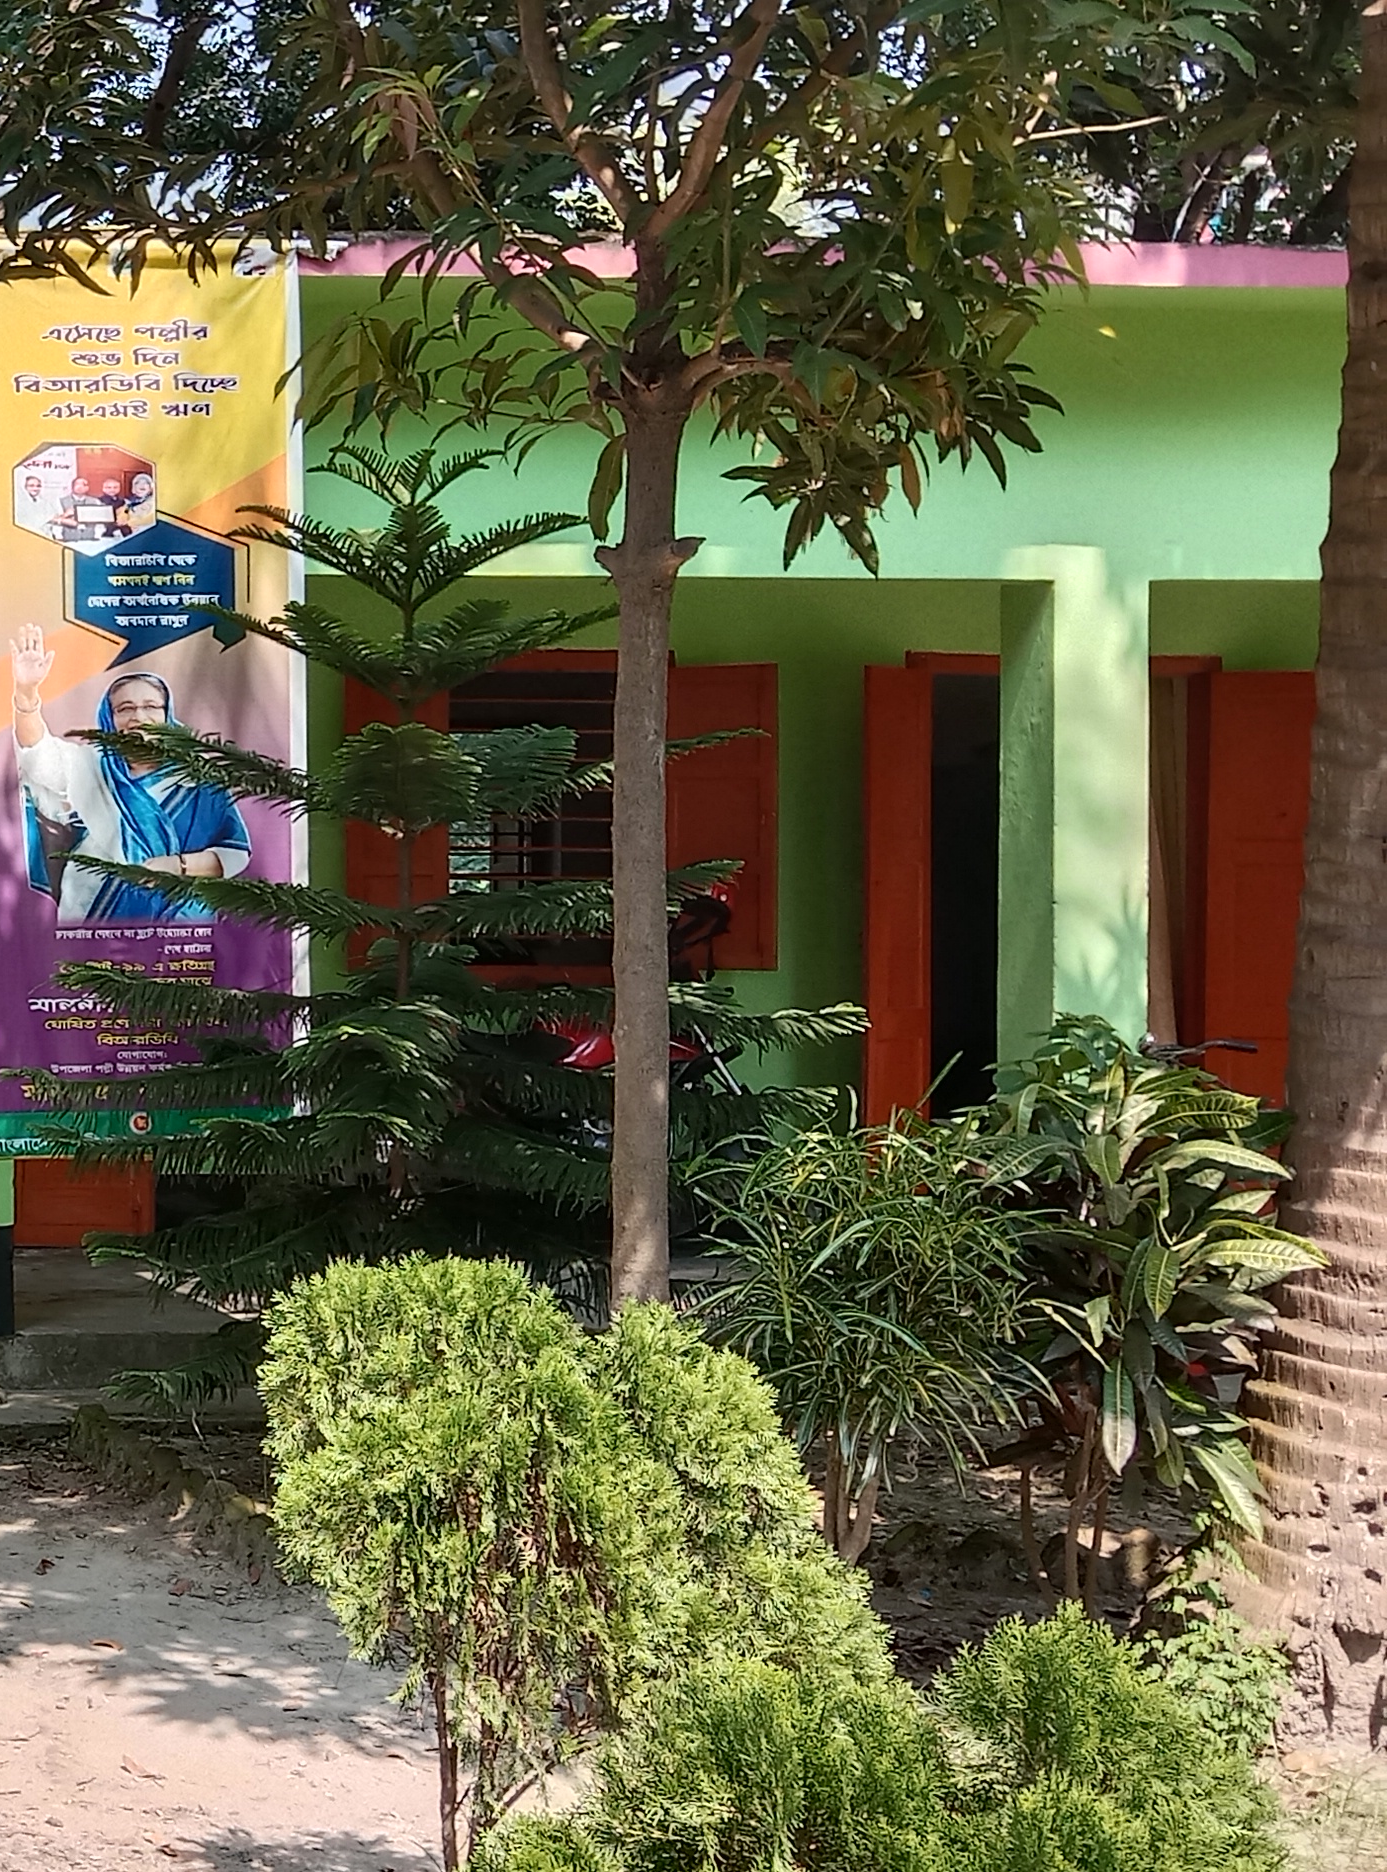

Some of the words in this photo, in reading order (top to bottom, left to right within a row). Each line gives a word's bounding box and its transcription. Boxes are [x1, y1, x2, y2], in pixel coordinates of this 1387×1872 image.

[42, 324, 122, 344] এসেছে
[134, 319, 209, 343] পল্লীর
[71, 353, 122, 367] শুভ
[133, 348, 180, 367] দিন
[13, 374, 161, 395] বিআরডিবি
[173, 373, 238, 394] দিচ্ছে
[42, 399, 150, 420] এসএমই
[161, 403, 211, 418] ঋণ
